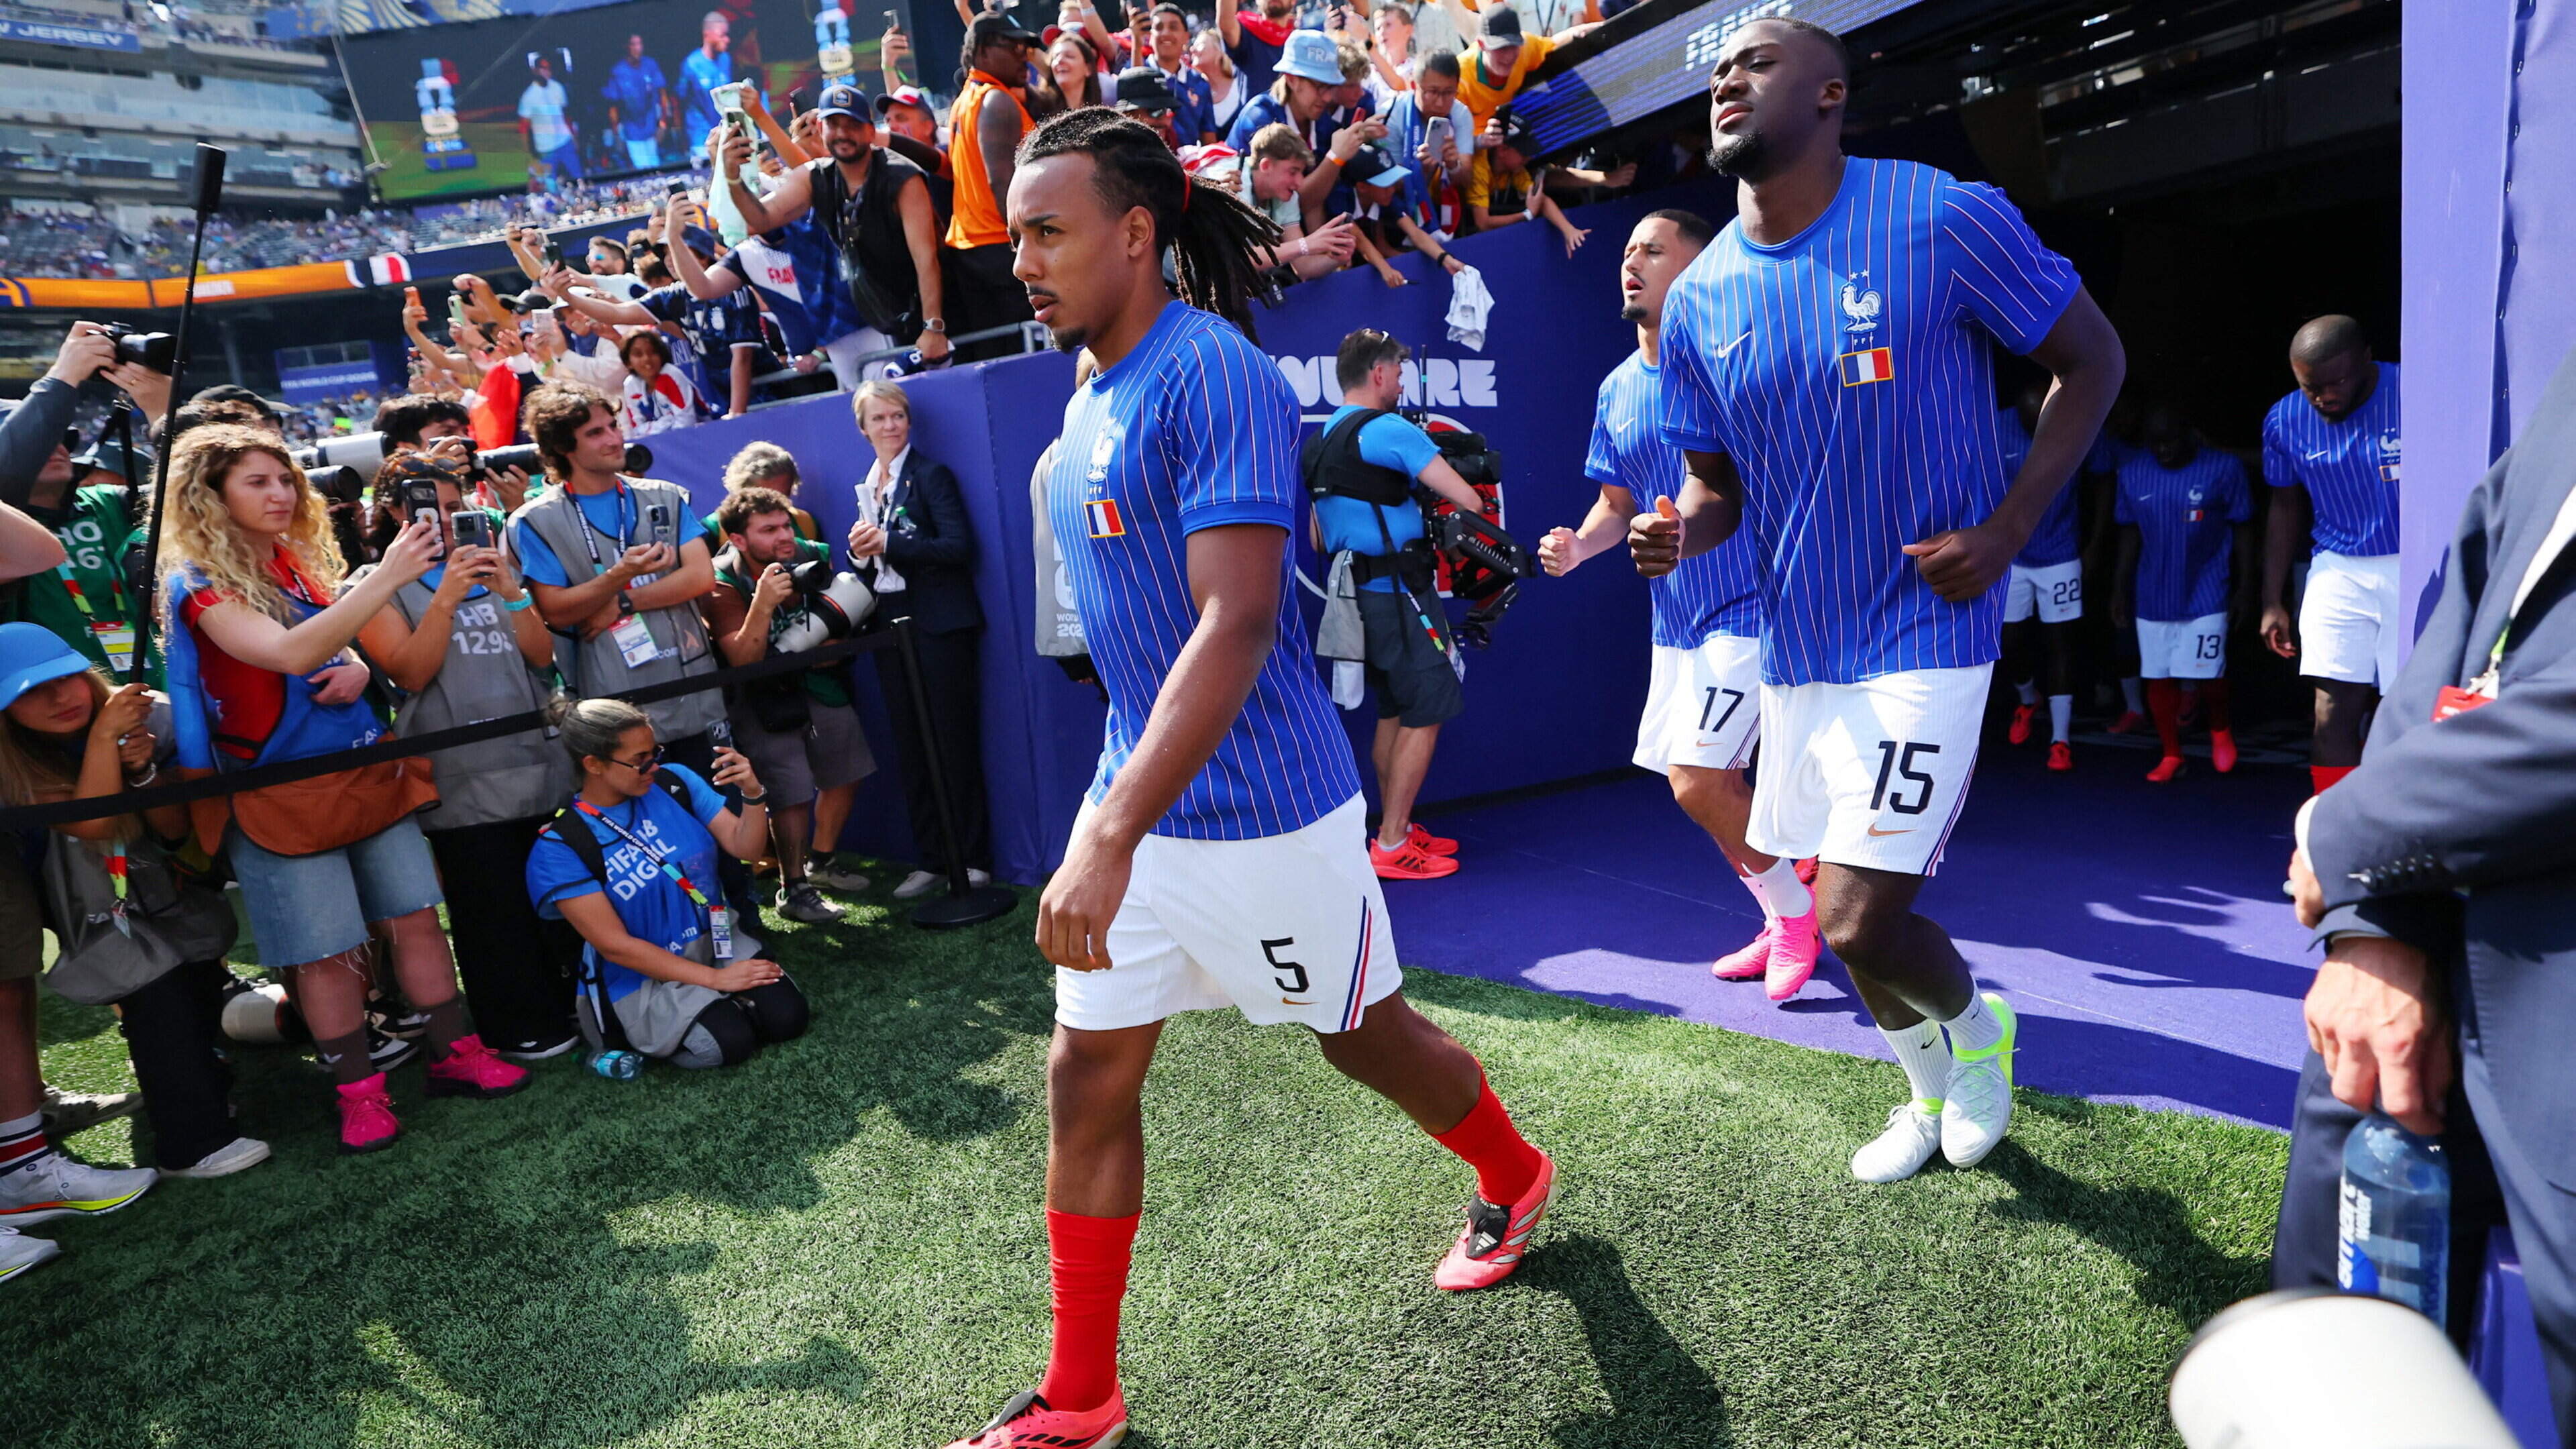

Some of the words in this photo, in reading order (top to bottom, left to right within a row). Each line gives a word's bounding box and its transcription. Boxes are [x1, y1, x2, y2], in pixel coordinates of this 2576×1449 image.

[17, 25, 123, 46] JERSEY
[2054, 578, 2082, 604] 22
[457, 603, 498, 627] HB
[2196, 635, 2221, 659] 13
[1699, 686, 1745, 733] 17
[1870, 741, 1941, 815] 15
[602, 816, 615, 827] FIFA
[613, 824, 634, 840] WORLD
[632, 837, 645, 848] CUP
[612, 838, 677, 901] DIGIL
[1260, 936, 1309, 993] 5
